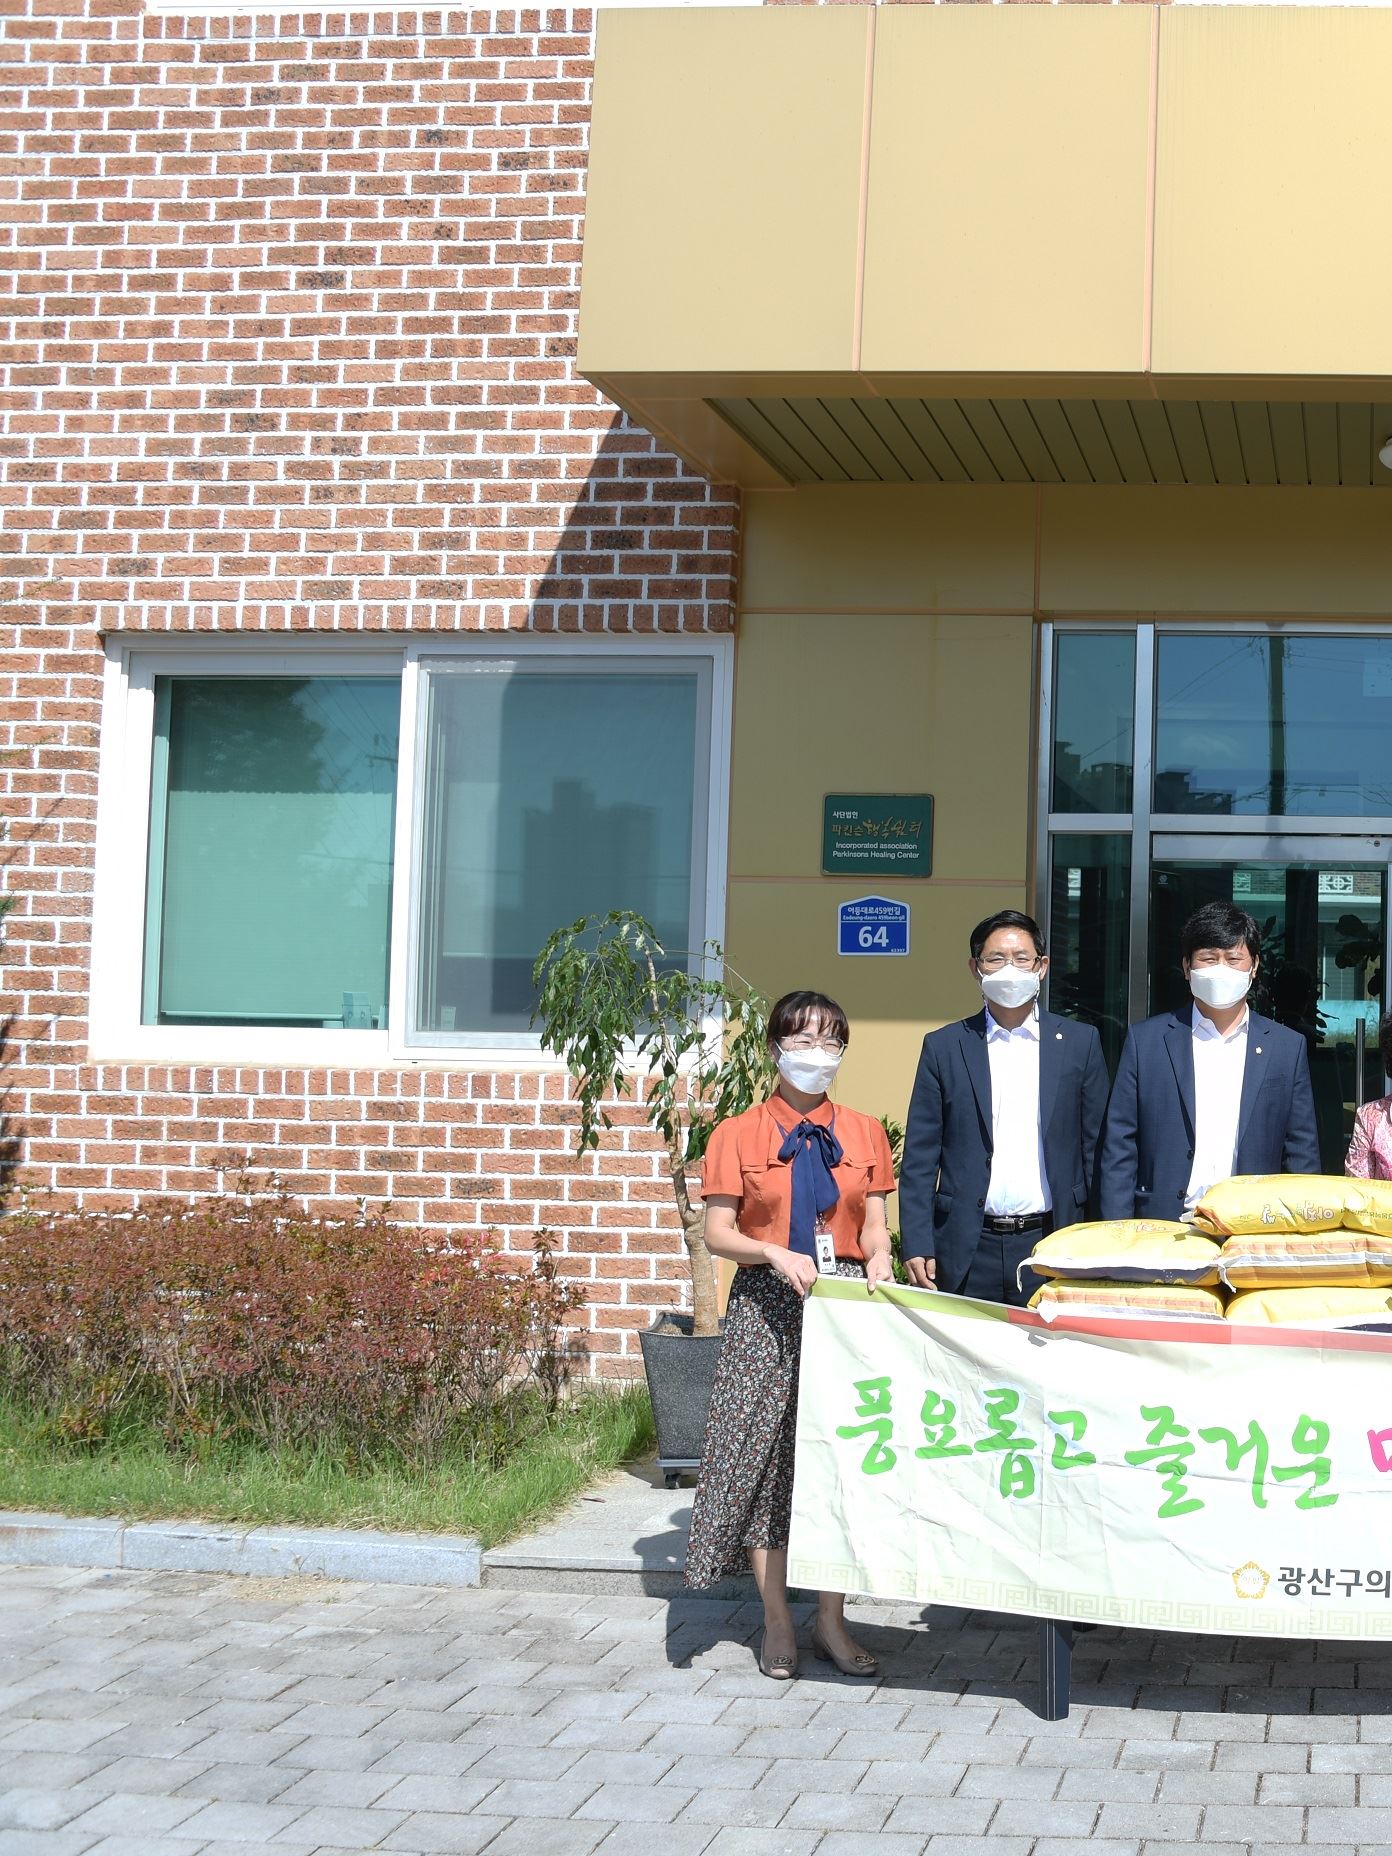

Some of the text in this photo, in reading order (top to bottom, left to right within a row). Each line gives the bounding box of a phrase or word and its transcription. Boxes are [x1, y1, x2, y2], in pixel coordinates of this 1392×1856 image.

[832, 810, 859, 819] 사단법인
[836, 842, 918, 850] Incorporated association
[832, 850, 869, 858] Parkinsons
[870, 851, 896, 859] Healing
[858, 926, 889, 947] 64
[836, 1376, 1096, 1499] 풍요롭고
[1124, 1404, 1339, 1519] 즐거운
